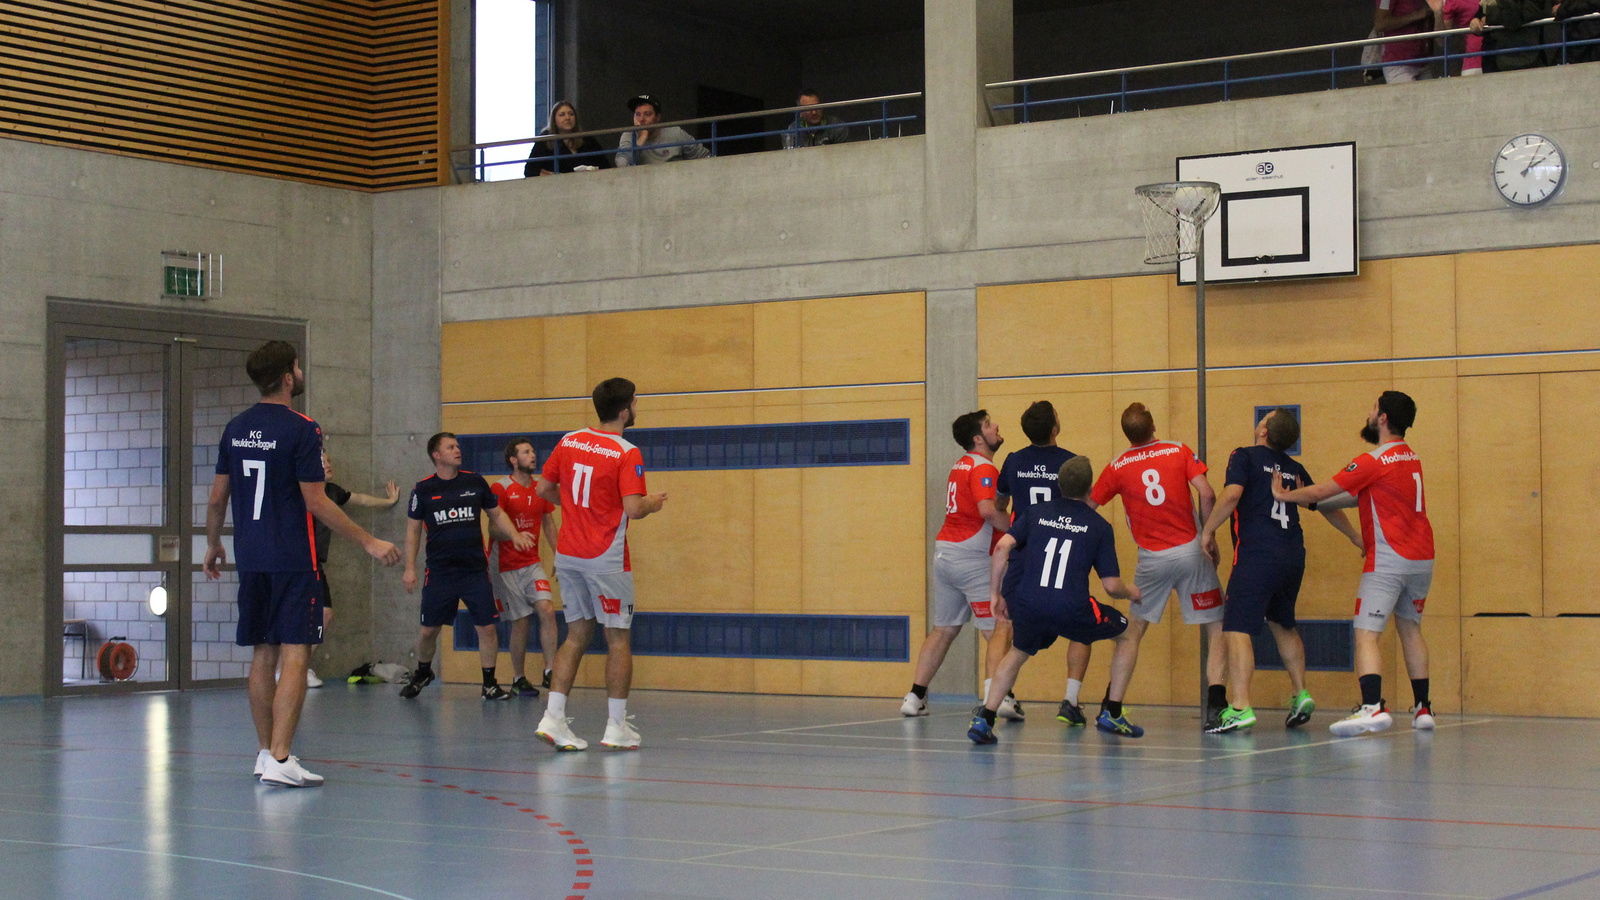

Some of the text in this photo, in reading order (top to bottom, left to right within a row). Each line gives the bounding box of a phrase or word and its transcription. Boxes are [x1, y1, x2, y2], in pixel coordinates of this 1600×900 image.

[250, 430, 262, 439] KG
[561, 437, 621, 459] Hochwald-Gempen
[1114, 447, 1180, 471] Hochwald-Gempen
[1034, 464, 1047, 472] KG
[242, 459, 266, 521] 7
[572, 462, 594, 508] 11
[1141, 468, 1166, 506] 8
[1412, 472, 1422, 512] 1
[1038, 518, 1088, 533] Neukirch-Roggwil
[1058, 515, 1072, 524] KG
[1271, 500, 1289, 529] 4
[1040, 537, 1073, 590] 11
[317, 625, 323, 639] 7
